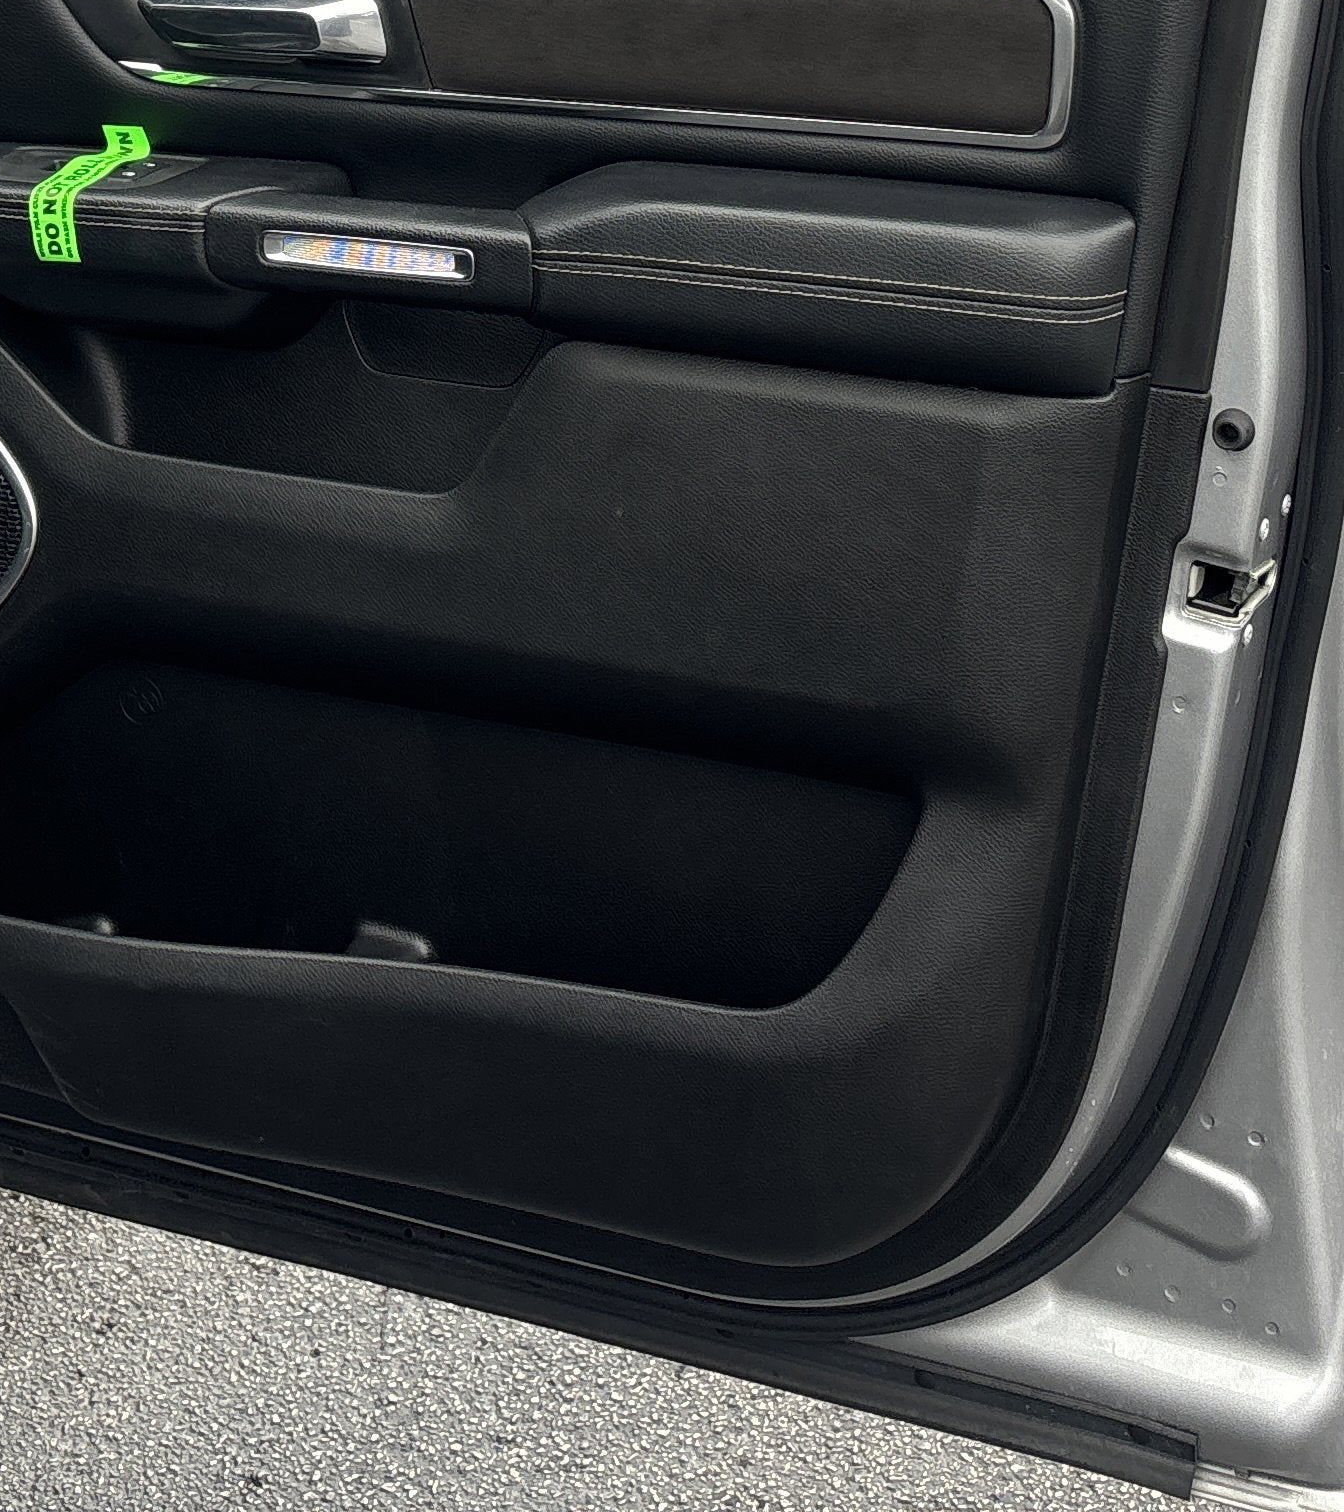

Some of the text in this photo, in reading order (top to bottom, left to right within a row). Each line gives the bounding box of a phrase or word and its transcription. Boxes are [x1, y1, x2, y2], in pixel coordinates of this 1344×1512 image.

[63, 158, 105, 182] ROLL
[42, 181, 69, 216] NOT
[44, 222, 64, 256] DO
